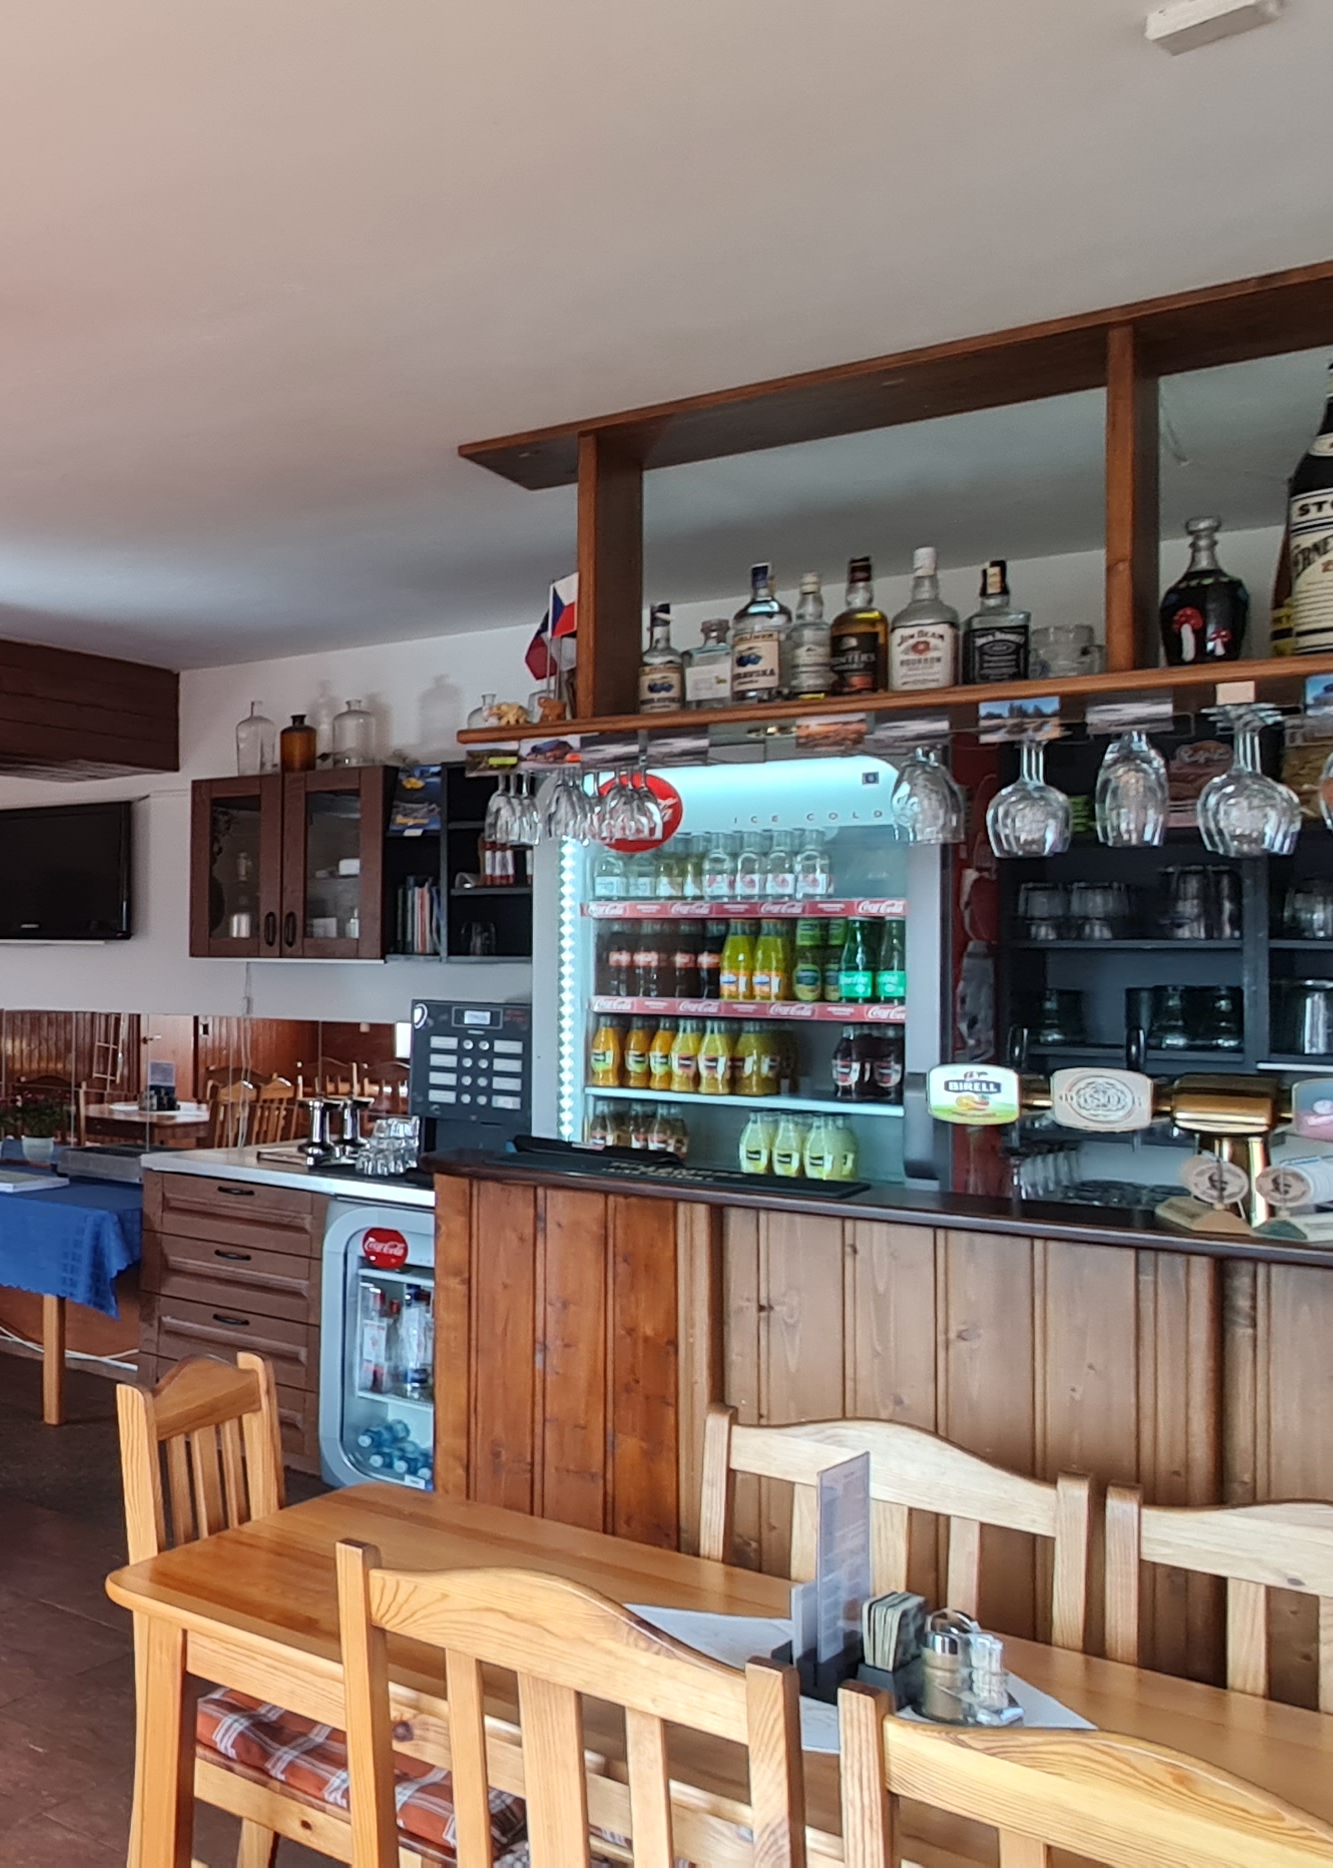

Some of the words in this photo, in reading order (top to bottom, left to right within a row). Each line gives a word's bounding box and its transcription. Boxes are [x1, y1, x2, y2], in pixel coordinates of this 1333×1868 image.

[1298, 500, 1333, 517] ST
[734, 815, 780, 825] ICE
[805, 809, 884, 822] COLD
[948, 1081, 998, 1093] BIRELL
